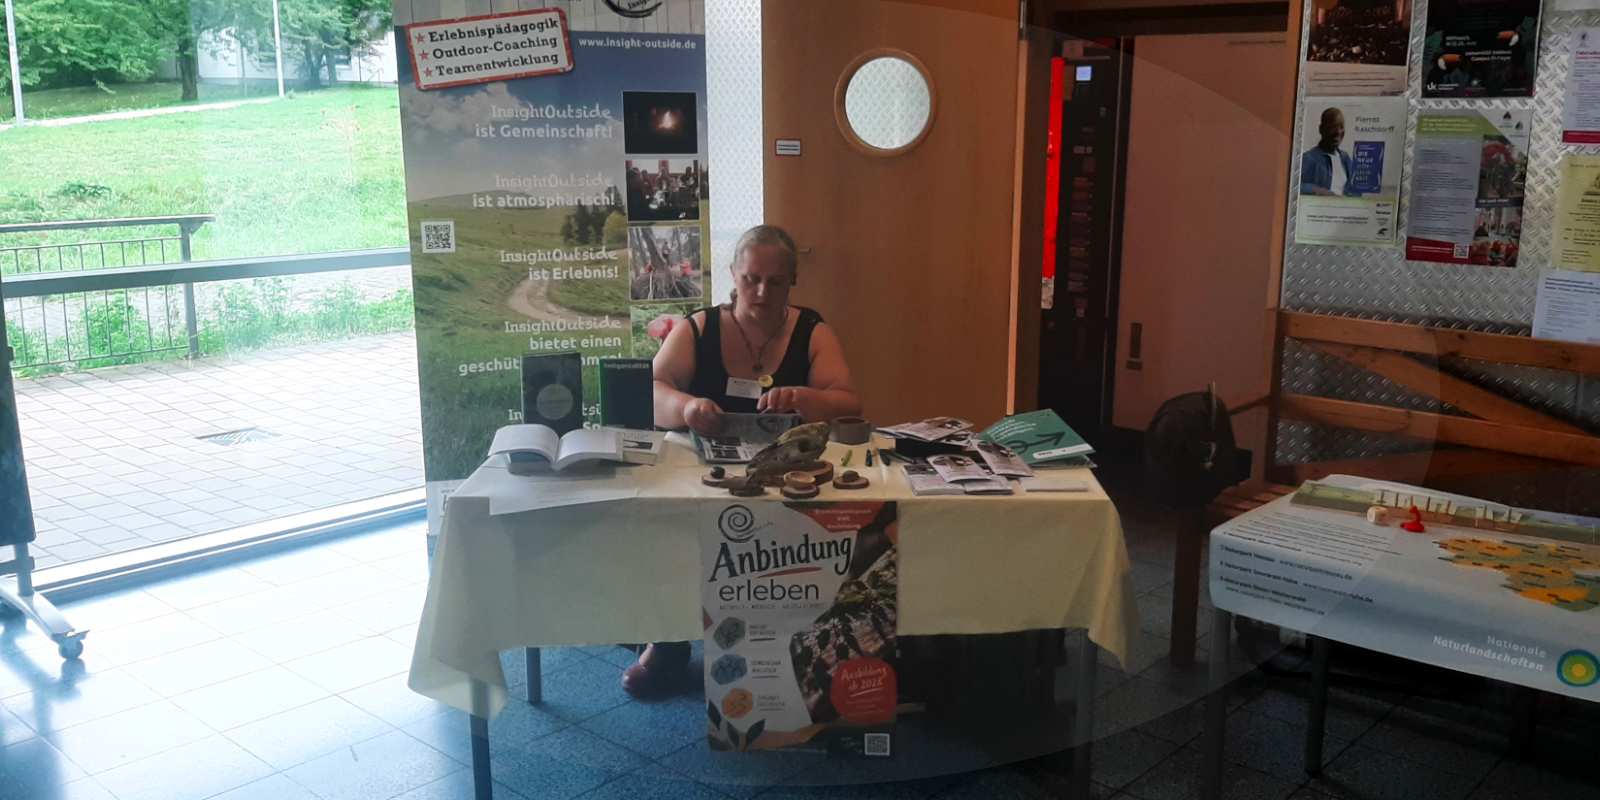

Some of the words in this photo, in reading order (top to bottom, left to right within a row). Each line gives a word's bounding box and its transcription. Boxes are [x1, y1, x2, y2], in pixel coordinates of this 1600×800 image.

[428, 18, 559, 43] Erlebnispädagogik
[432, 36, 558, 60] Outdoor-Coaching
[579, 37, 697, 50] www.insight-outside.de
[436, 53, 559, 77] Teamentwicklung
[475, 126, 496, 138] ist
[500, 124, 613, 138] Gemeinschaft!
[473, 195, 493, 208] ist
[497, 193, 616, 209] atmosphärisch!
[529, 268, 549, 281] ist
[553, 266, 619, 281] Erlebnis!
[530, 337, 577, 351] bietet
[581, 335, 622, 348] einen
[458, 357, 520, 377] geschüt
[708, 533, 852, 583] Anbindung
[719, 579, 820, 602] erleben
[1433, 635, 1544, 671] Naturlandschaften
[1487, 635, 1547, 658] Nationale
[841, 665, 887, 682] Ausbildung
[848, 680, 859, 691] ab
